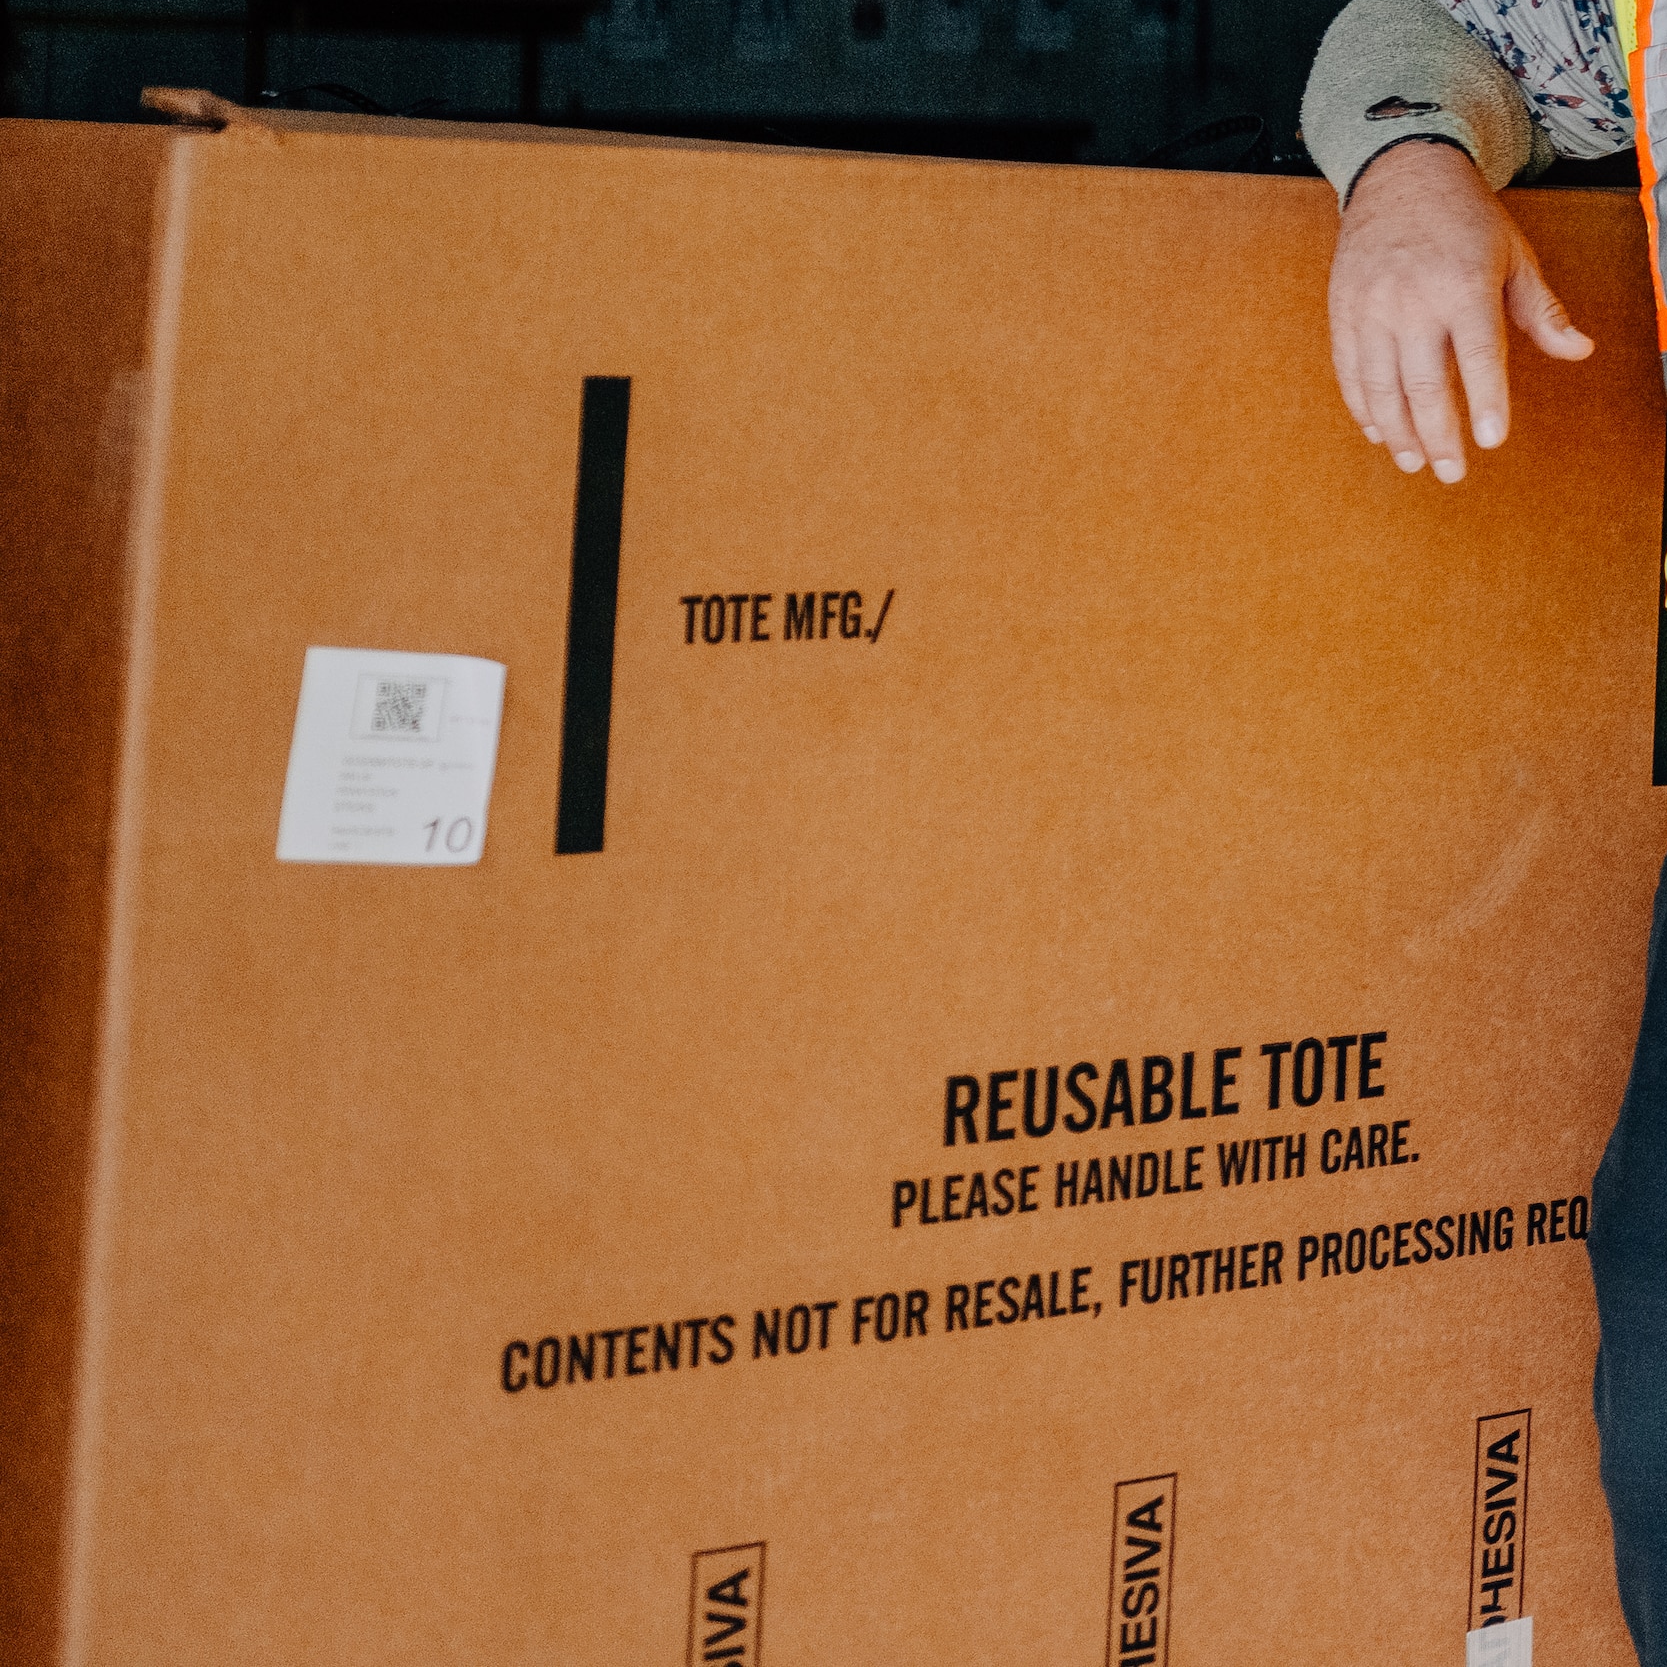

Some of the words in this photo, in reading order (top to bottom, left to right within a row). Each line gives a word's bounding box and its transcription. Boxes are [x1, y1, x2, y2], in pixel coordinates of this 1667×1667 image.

[680, 593, 773, 646] TOTE
[783, 587, 897, 645] MFG./
[423, 815, 474, 855] 10
[942, 1046, 1243, 1147] REUSABLE
[1259, 1031, 1388, 1111] TOTE
[891, 1165, 1041, 1229] PLEASE
[1054, 1145, 1205, 1209] HANDLE
[1217, 1133, 1307, 1188] WITH
[1319, 1118, 1421, 1175] CARE.
[500, 1313, 737, 1395] CONTENTS
[752, 1300, 839, 1361] NOT
[851, 1288, 930, 1346] FOR
[944, 1266, 1103, 1333] RESALE,
[1118, 1240, 1285, 1309] FURTHER
[1297, 1206, 1516, 1283] PROCESSING
[703, 1566, 751, 1667] IVA
